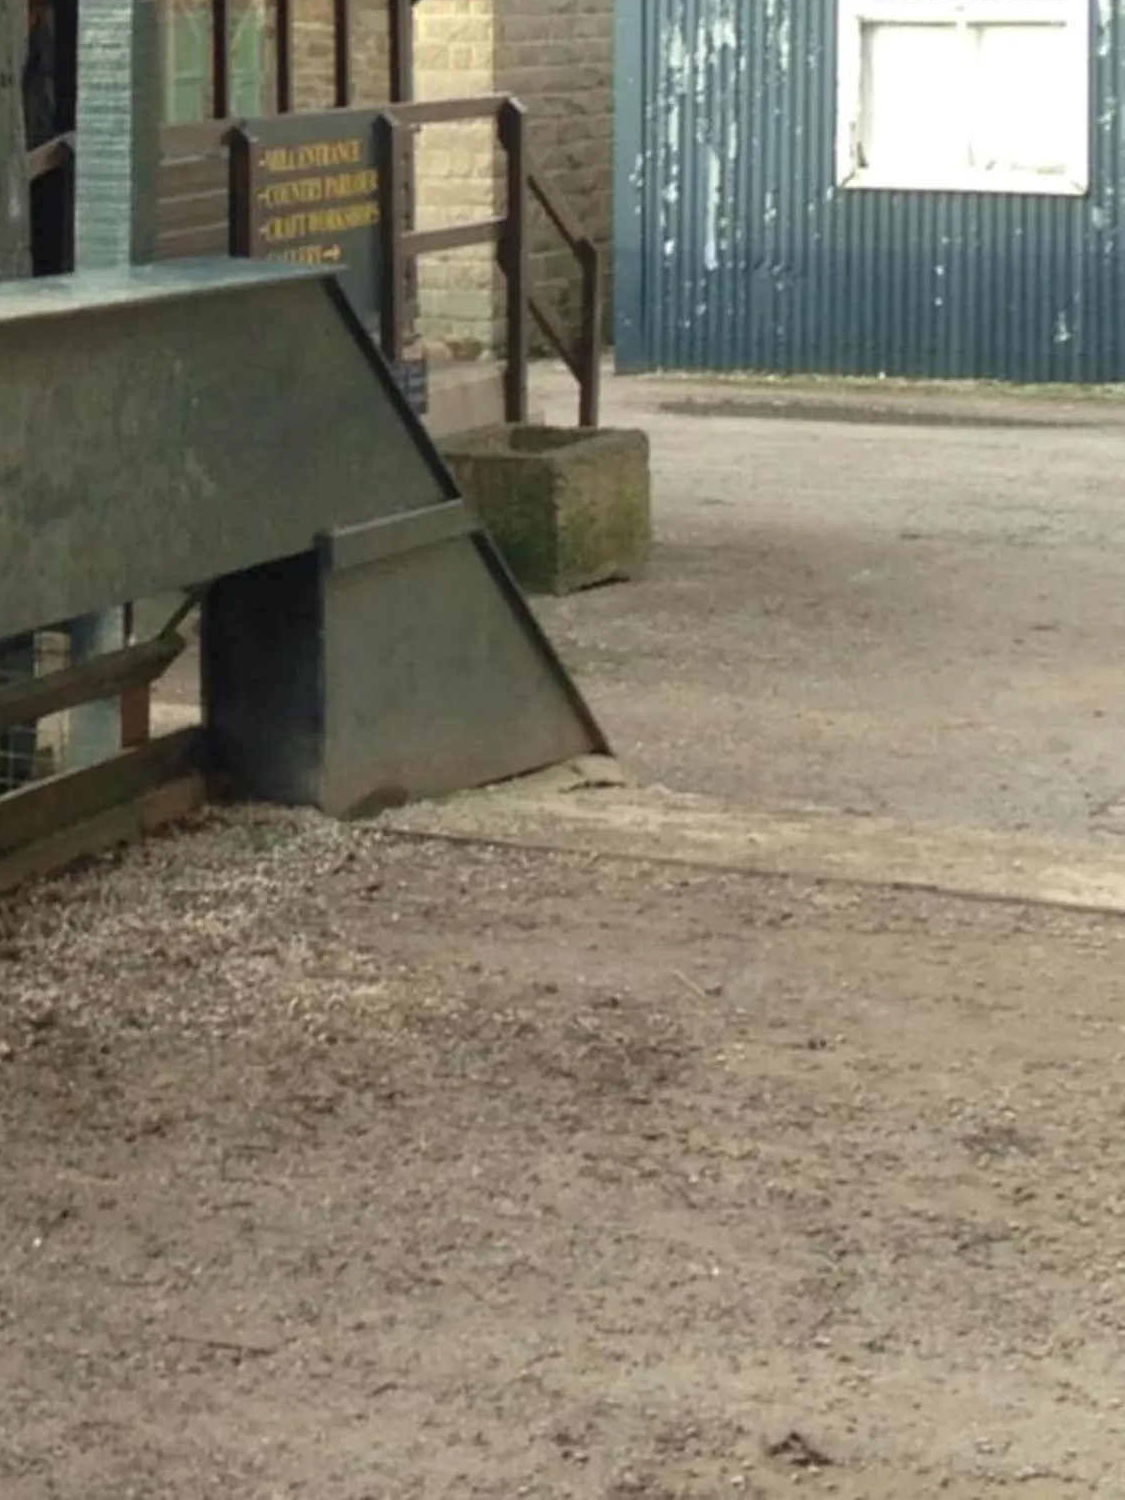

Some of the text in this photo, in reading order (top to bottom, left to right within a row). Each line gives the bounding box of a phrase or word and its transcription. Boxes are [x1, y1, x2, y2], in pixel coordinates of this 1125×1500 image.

[298, 139, 361, 169] ENTRANCE
[266, 176, 322, 206] COUNTRY
[266, 201, 380, 242] CRAFT WORKSHOPS
